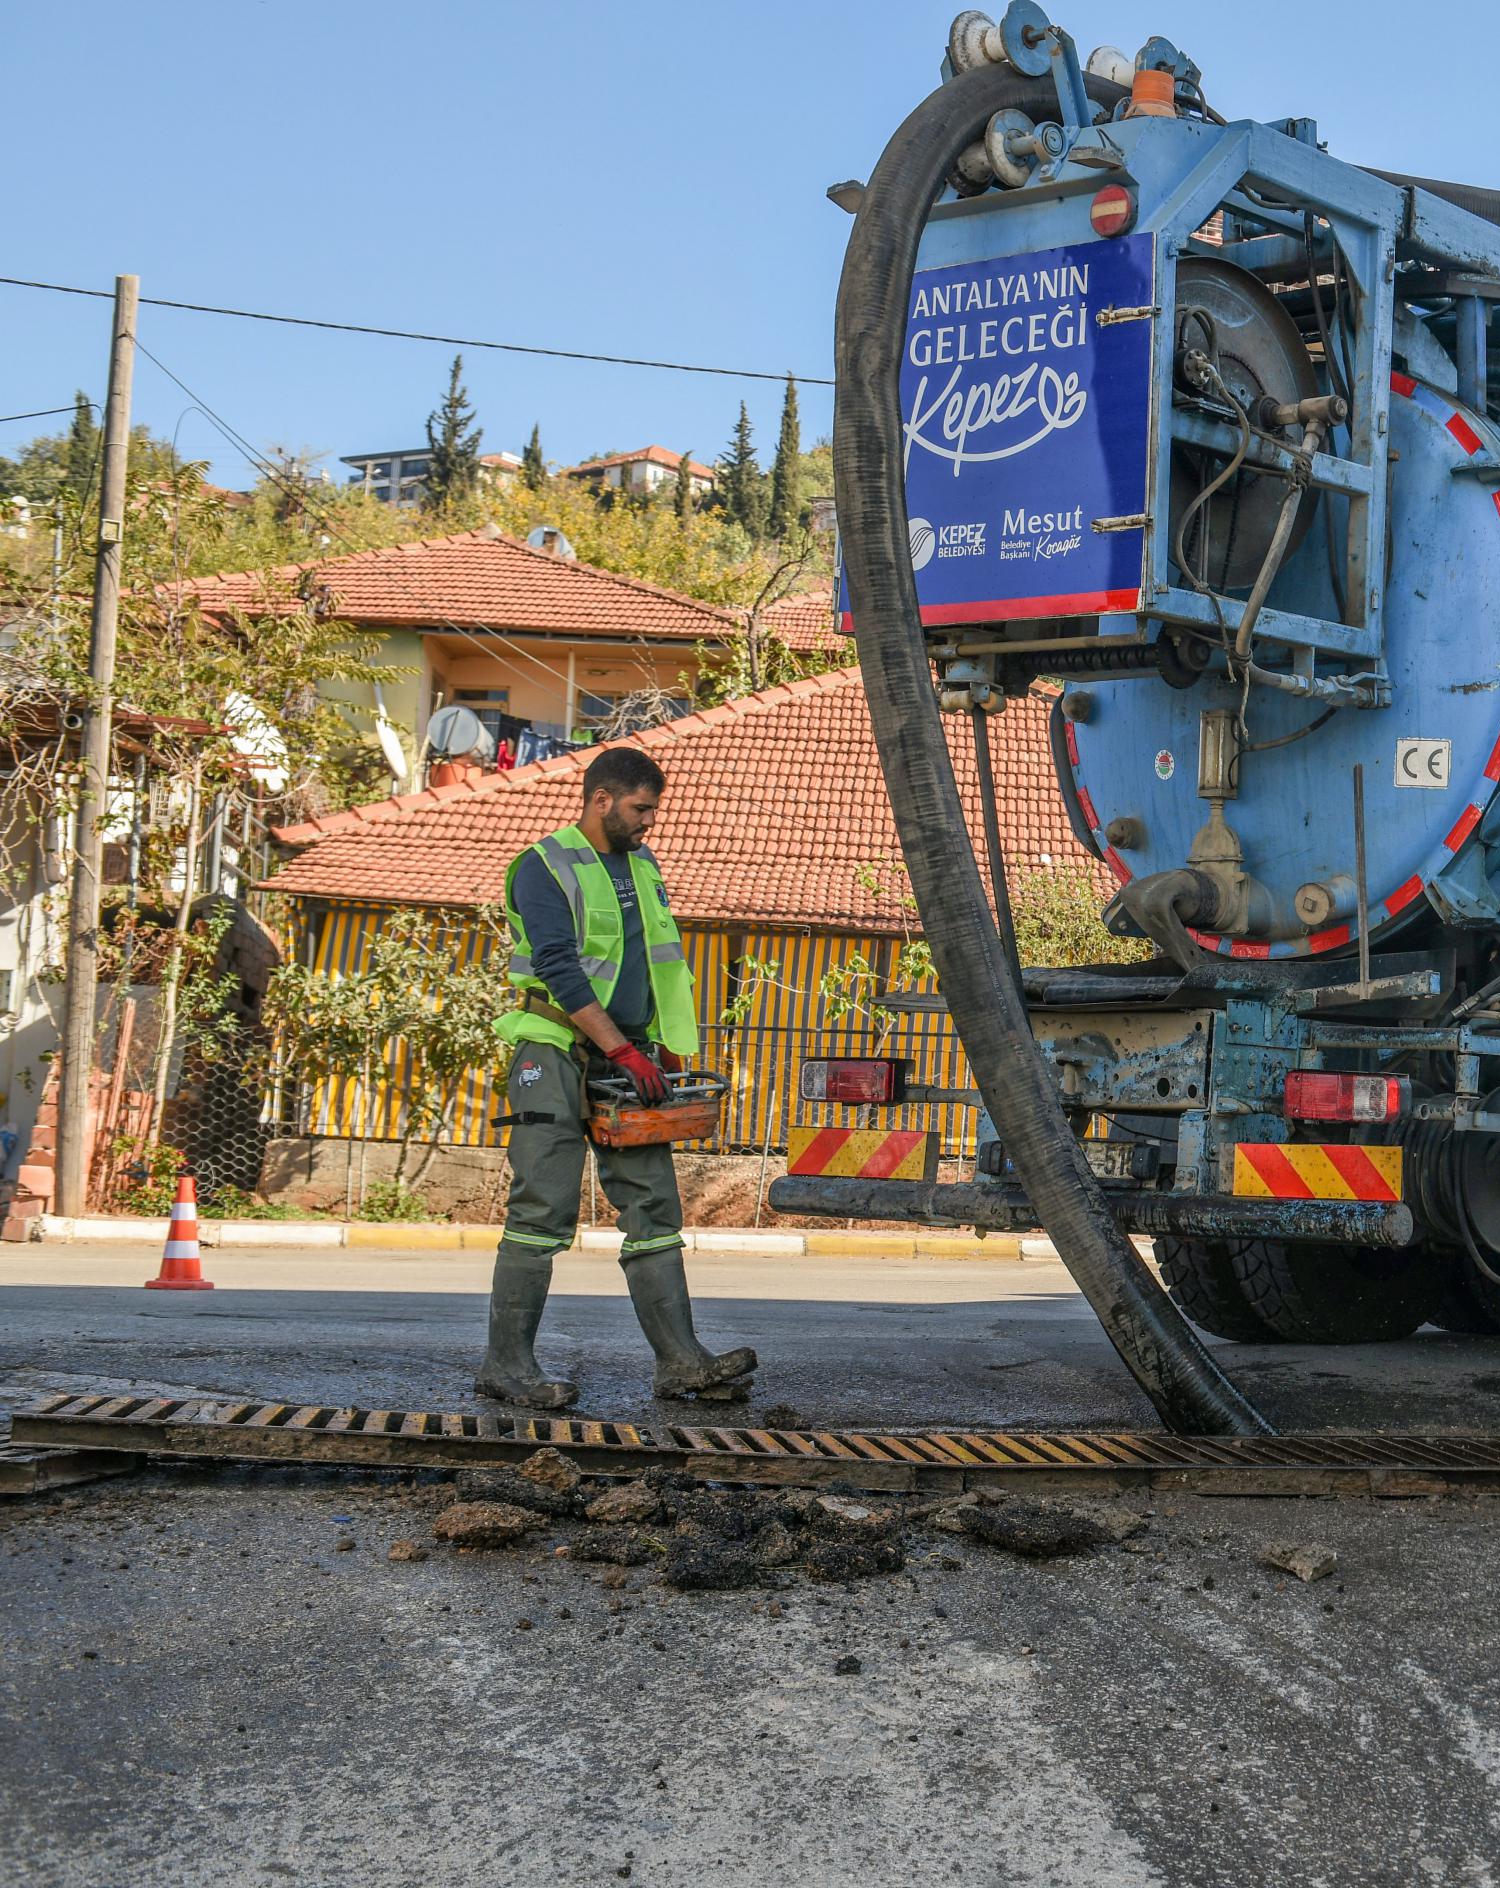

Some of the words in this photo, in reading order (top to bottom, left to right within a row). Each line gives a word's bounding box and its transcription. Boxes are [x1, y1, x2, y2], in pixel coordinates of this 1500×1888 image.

[912, 263, 1089, 319] ANTALYA'NIN
[909, 302, 1088, 367] GELECEĞİ
[939, 522, 987, 546] KEPEZ
[1002, 504, 1083, 537] Mesut
[938, 543, 987, 558] BELEDİYESİ
[1000, 550, 1031, 561] Başkanı
[1001, 540, 1032, 551] Belediye
[1034, 533, 1083, 563] Kocagöz
[1403, 747, 1443, 780] CE
